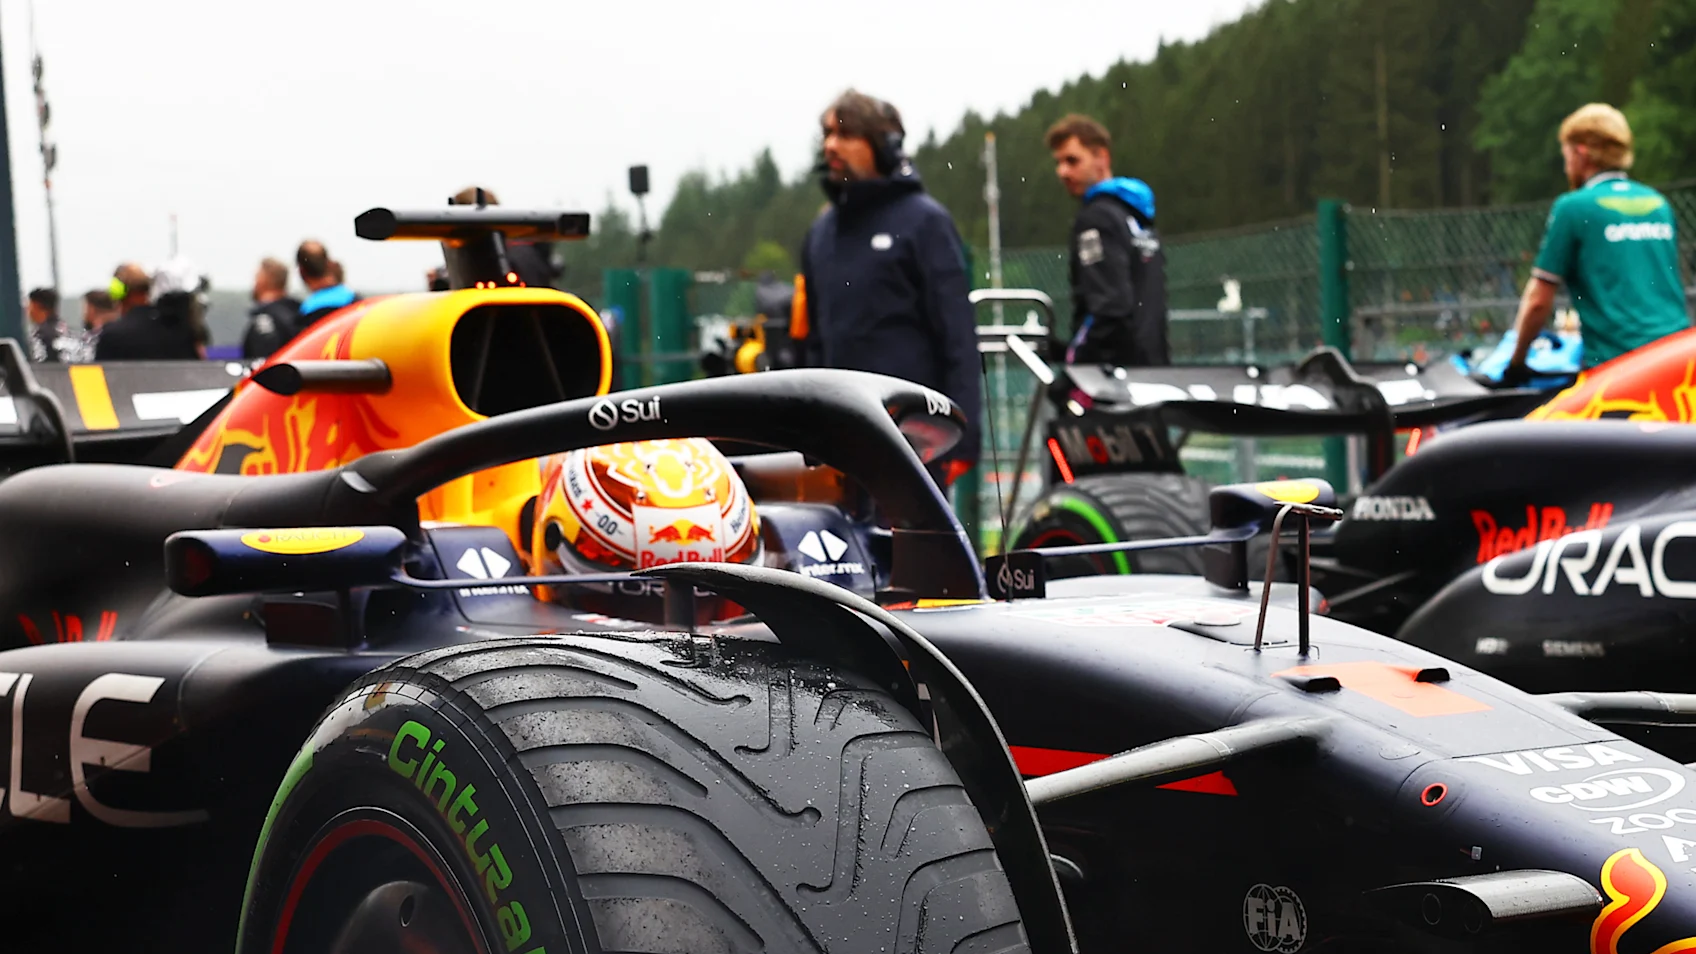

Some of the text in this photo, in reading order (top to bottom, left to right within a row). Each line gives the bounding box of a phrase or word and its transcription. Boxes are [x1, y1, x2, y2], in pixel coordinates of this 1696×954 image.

[621, 395, 661, 423] Sui
[1353, 496, 1436, 520] HONDA
[1540, 502, 1614, 540] Bll
[1014, 570, 1034, 590] Sui
[1457, 743, 1644, 776] VISA
[1529, 775, 1654, 804] CDW
